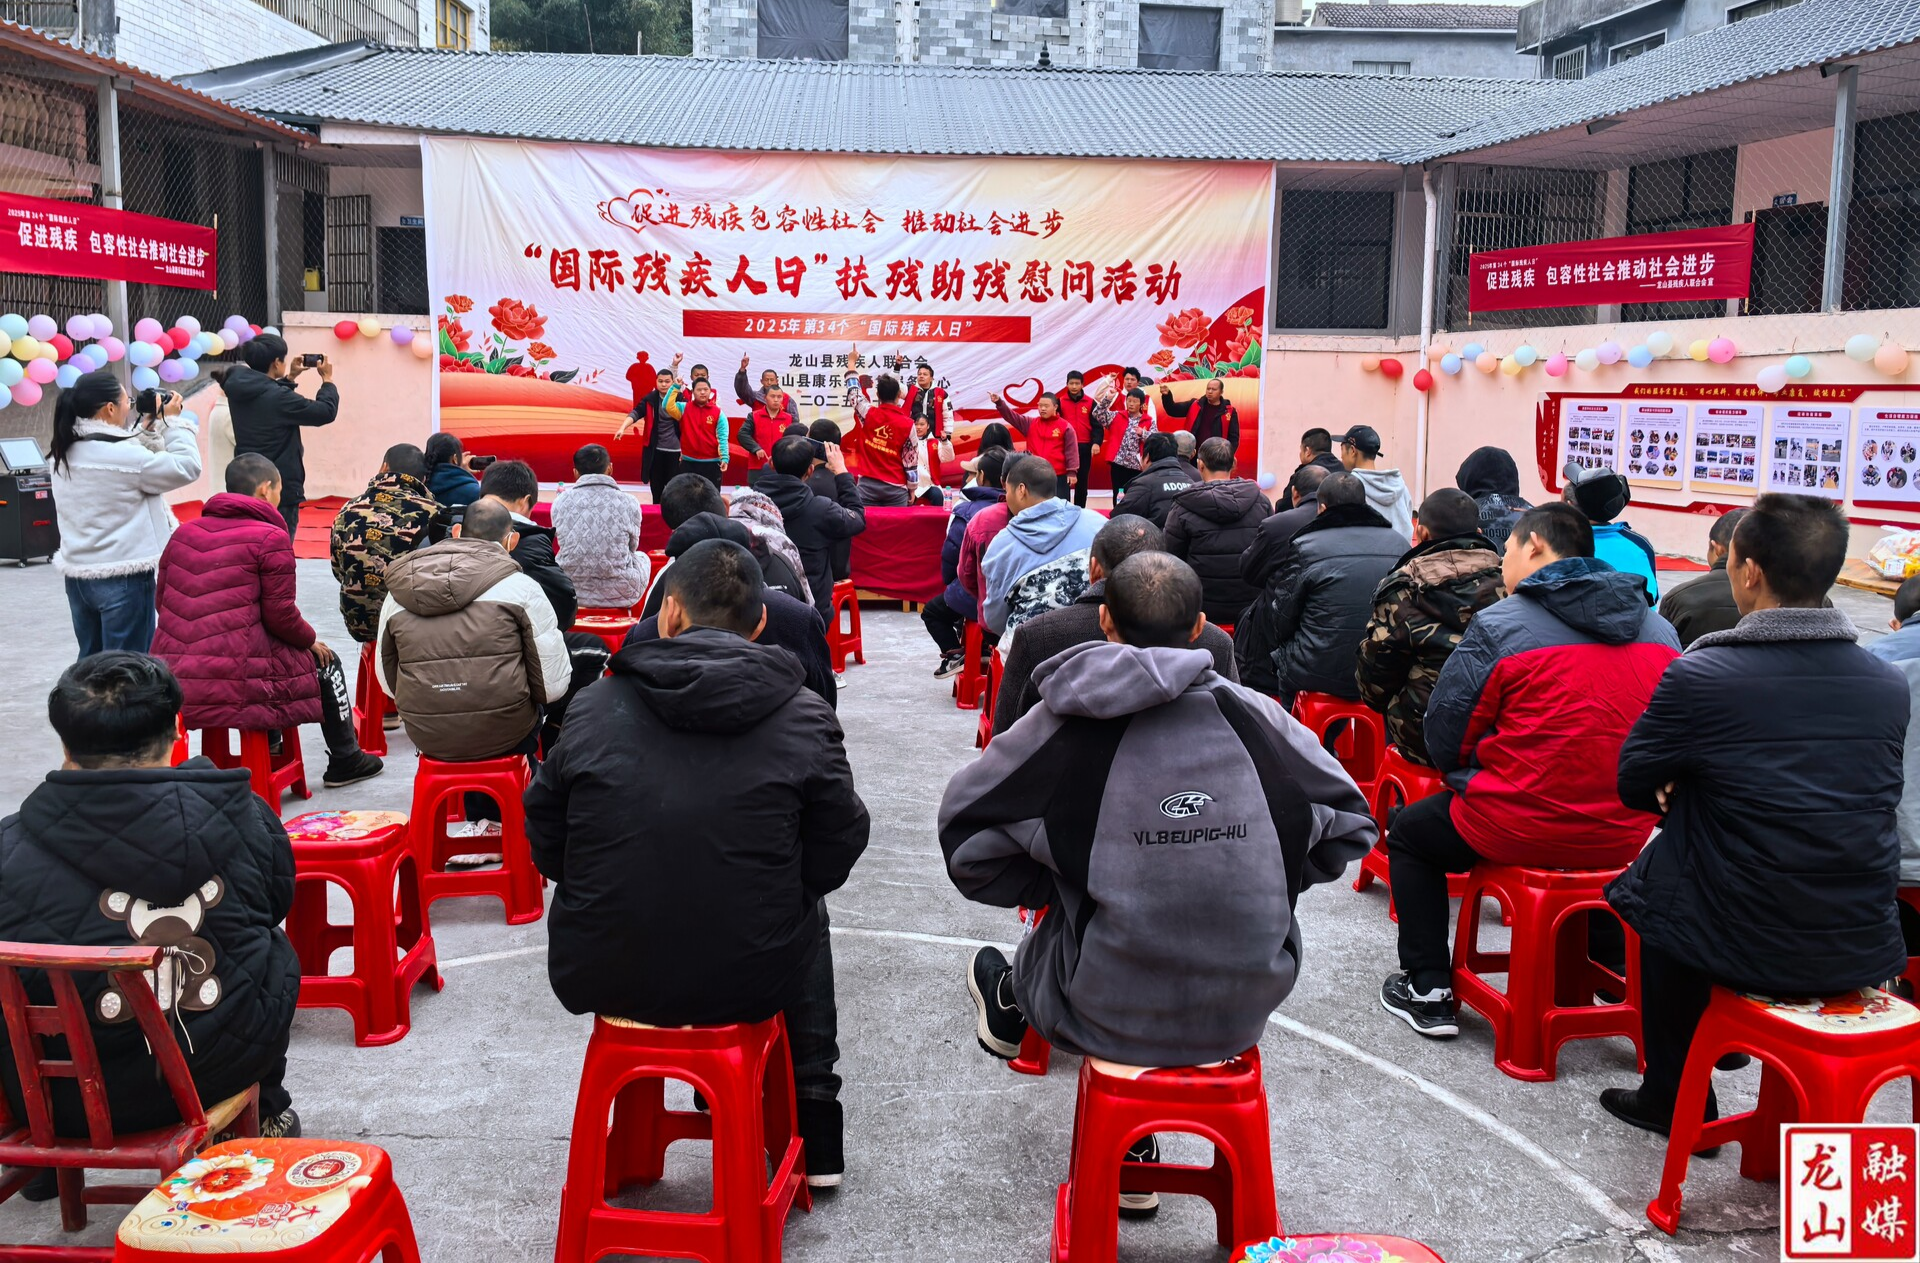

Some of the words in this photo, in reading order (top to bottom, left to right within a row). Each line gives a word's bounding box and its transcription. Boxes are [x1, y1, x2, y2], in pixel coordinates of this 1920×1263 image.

[631, 202, 884, 233] 促进残疾包容性社会
[901, 208, 1065, 240] 推动社会进步
[18, 221, 78, 252] 促进残疾
[89, 230, 205, 268] 包容性社会推动社会进步
[1487, 268, 1535, 291] 促进残疾
[1546, 252, 1716, 286] 包容性社会推动社会进步
